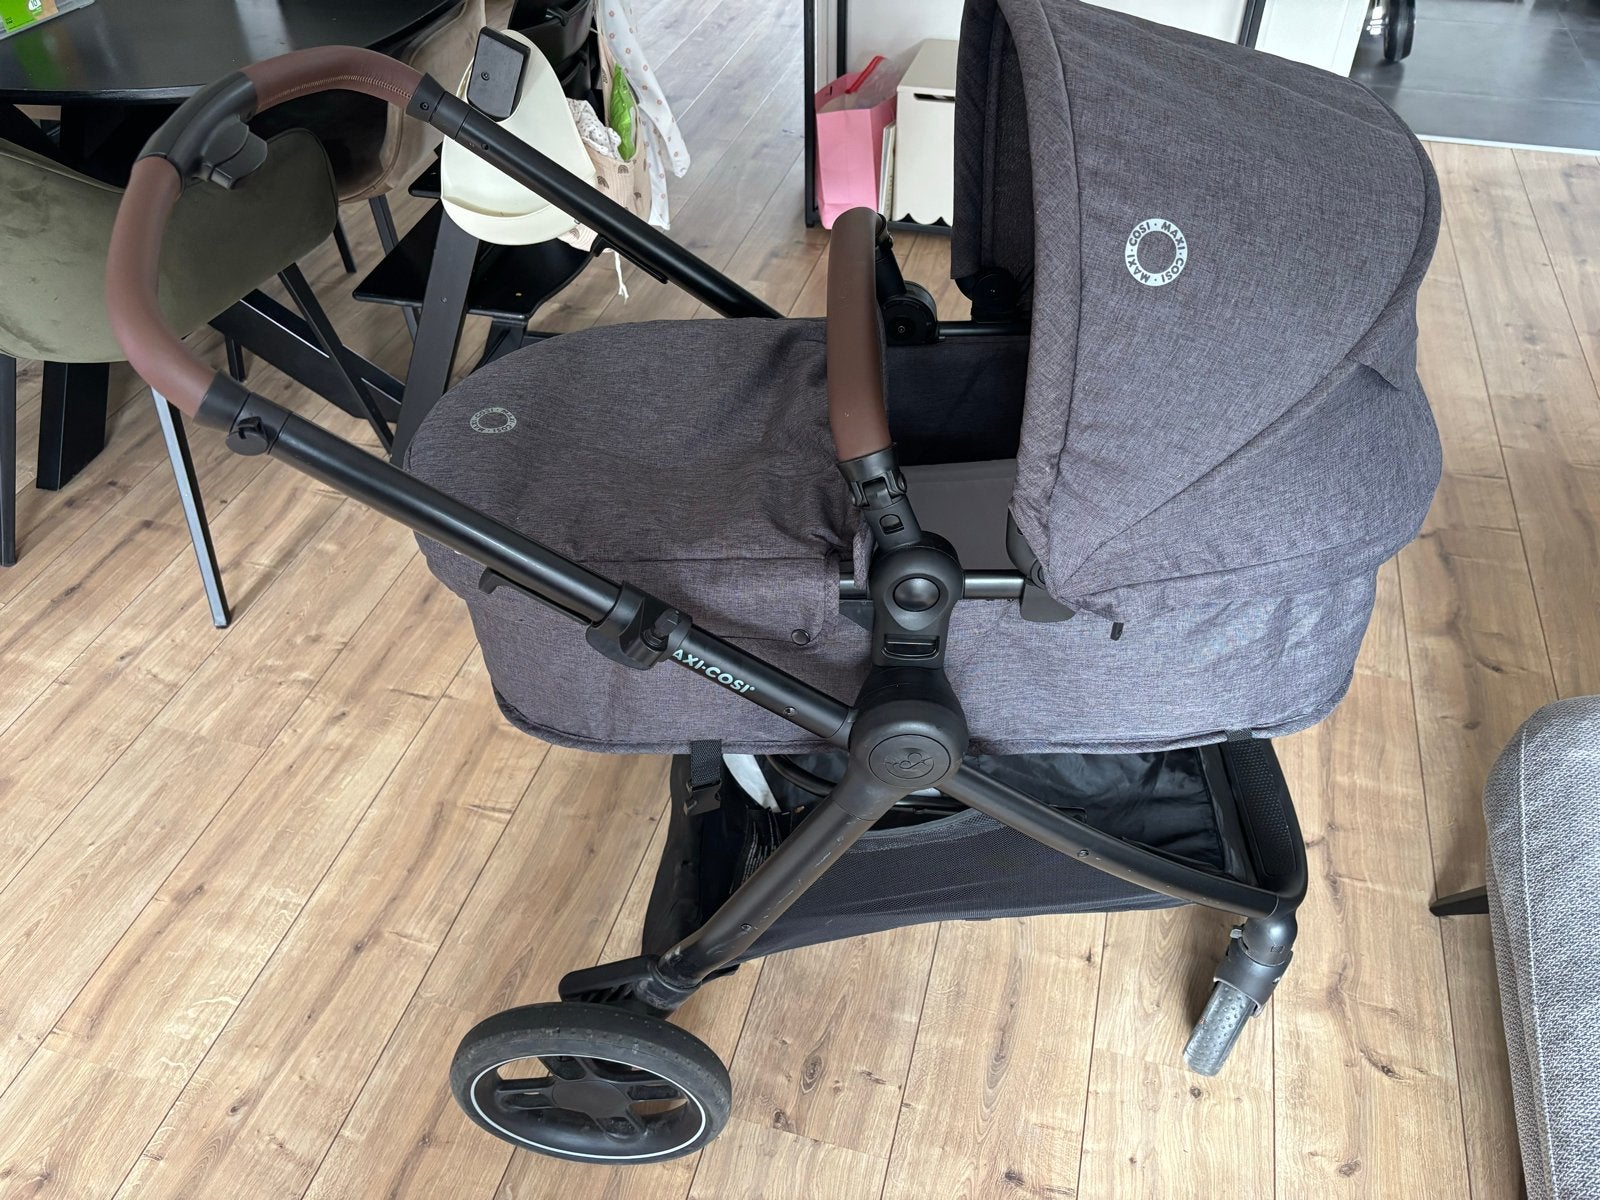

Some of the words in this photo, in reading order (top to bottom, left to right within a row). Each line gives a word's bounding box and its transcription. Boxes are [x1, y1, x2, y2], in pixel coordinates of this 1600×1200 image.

[1128, 221, 1151, 246] COSI
[1161, 221, 1186, 250] MAXI
[1127, 254, 1151, 283] MAXI
[1161, 257, 1185, 283] COSI
